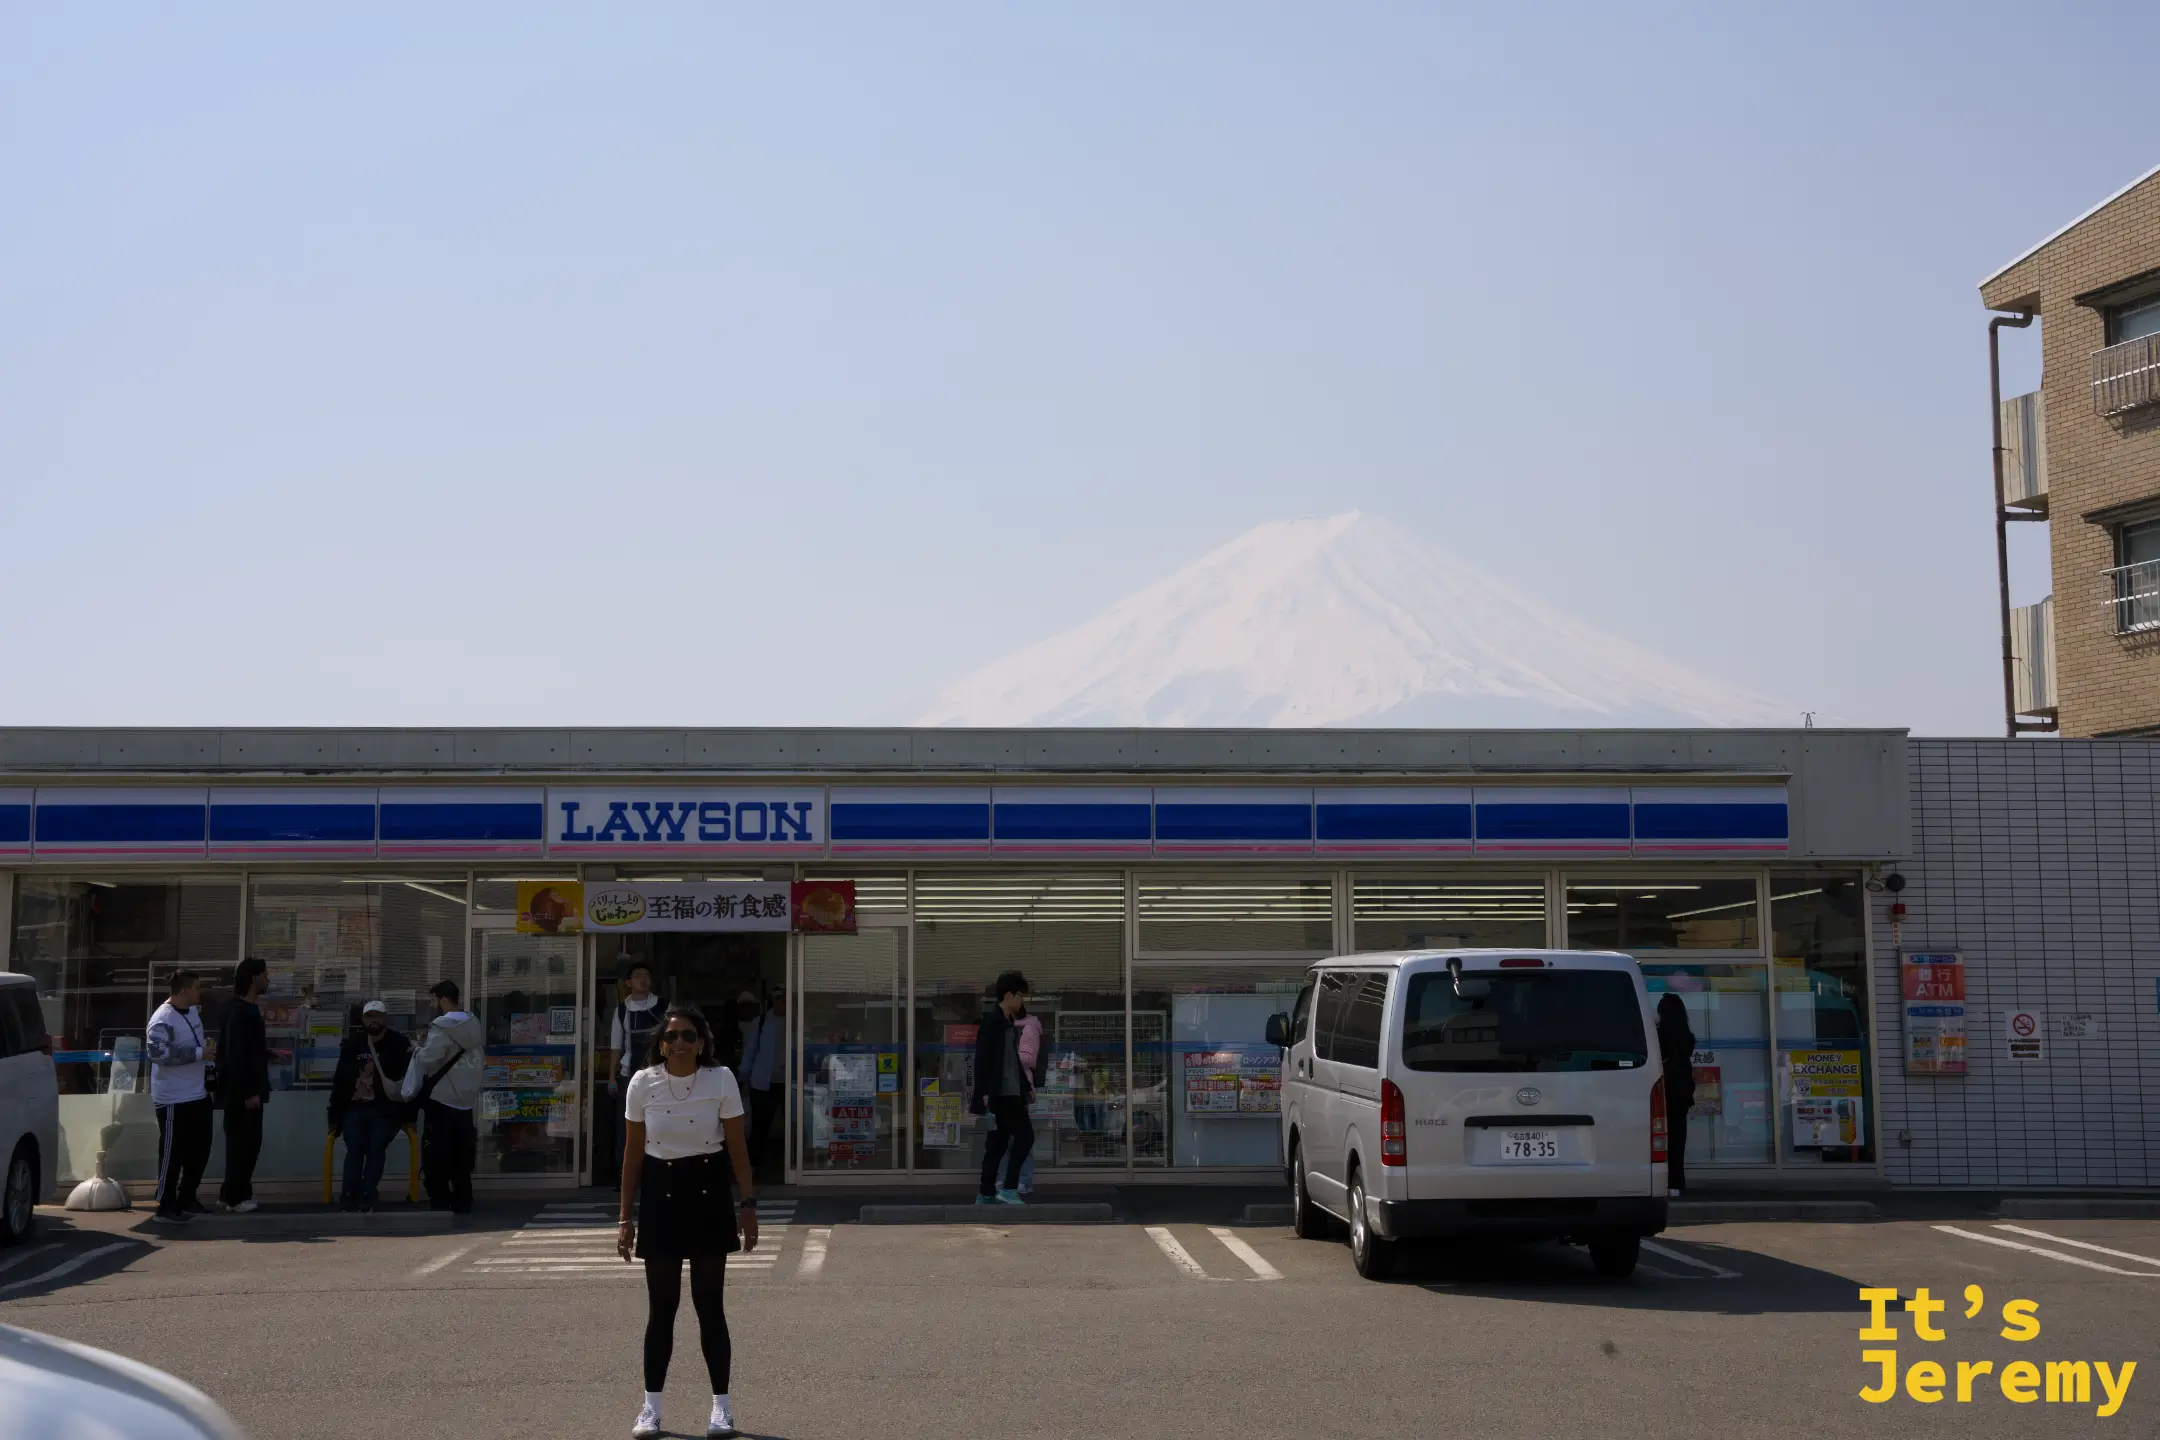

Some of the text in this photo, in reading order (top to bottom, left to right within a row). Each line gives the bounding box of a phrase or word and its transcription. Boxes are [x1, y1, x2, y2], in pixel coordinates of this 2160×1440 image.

[560, 802, 812, 842] LAWSON
[647, 894, 787, 919] 至福の新食感
[1915, 983, 1953, 997] ATM
[1807, 1054, 1842, 1063] MONEY
[1793, 1064, 1858, 1075] EXCHANGE
[837, 1107, 869, 1118] ATM
[1414, 1118, 1449, 1126] HIACE
[1513, 1141, 1556, 1158] 78-35
